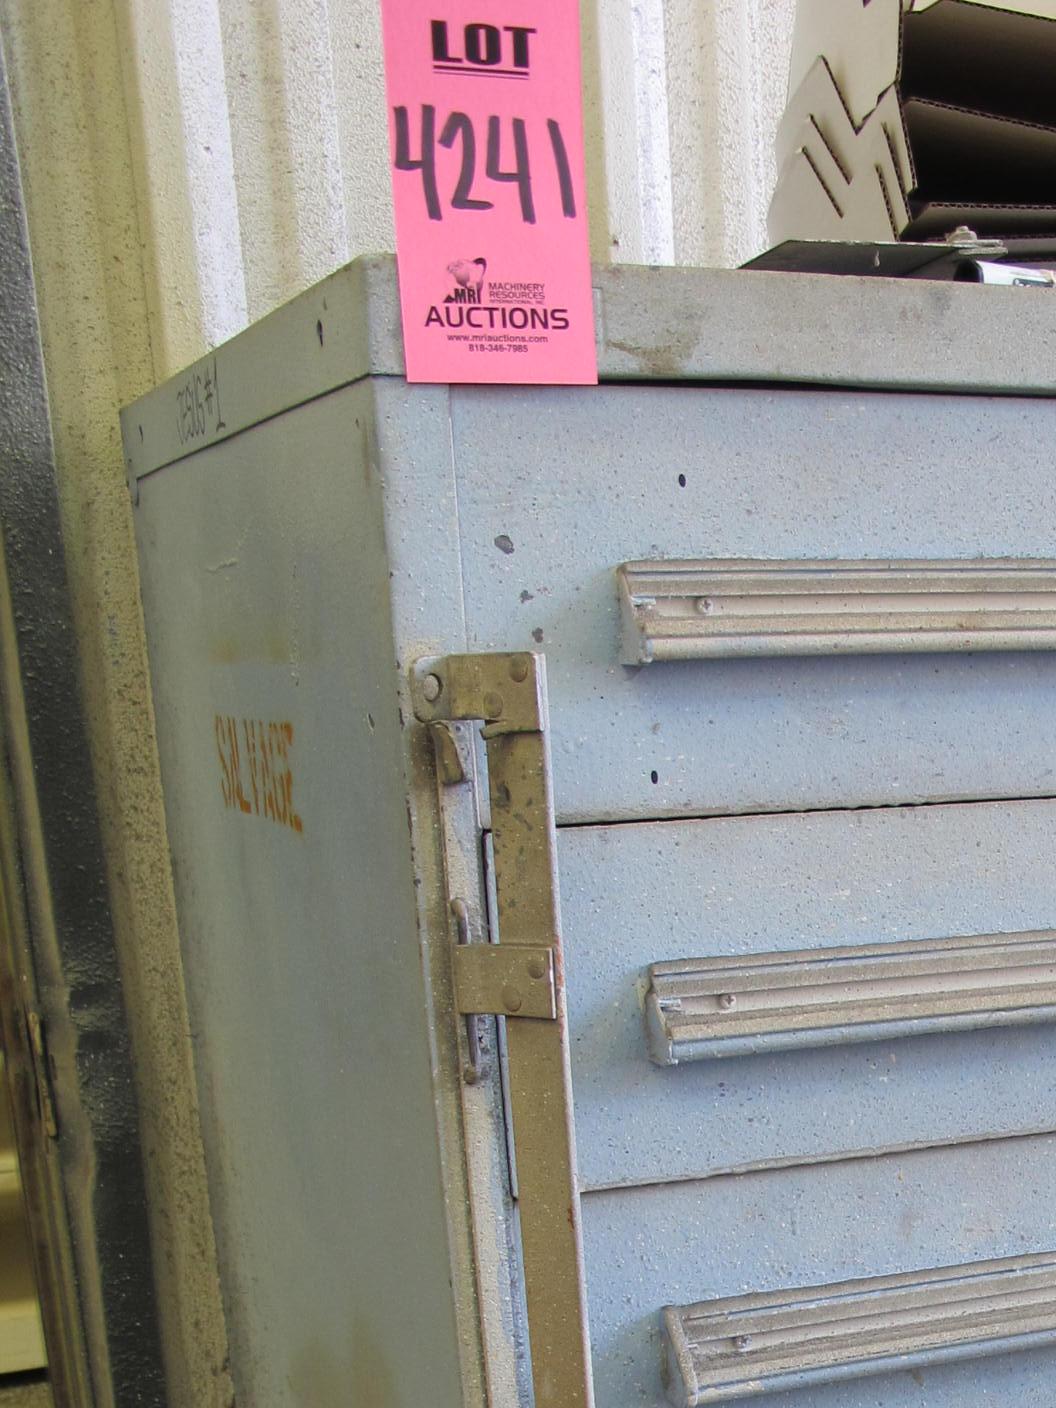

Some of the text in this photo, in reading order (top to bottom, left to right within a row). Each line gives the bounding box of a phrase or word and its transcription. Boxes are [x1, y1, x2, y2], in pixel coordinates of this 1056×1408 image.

[431, 20, 537, 69] LOT
[393, 104, 577, 225] 4241
[488, 282, 545, 292] MACHINERY
[453, 288, 482, 304] MRI
[489, 291, 546, 300] RESOURCES
[424, 306, 570, 330] AUCTIONS
[447, 334, 549, 343] www.mriauctions.com
